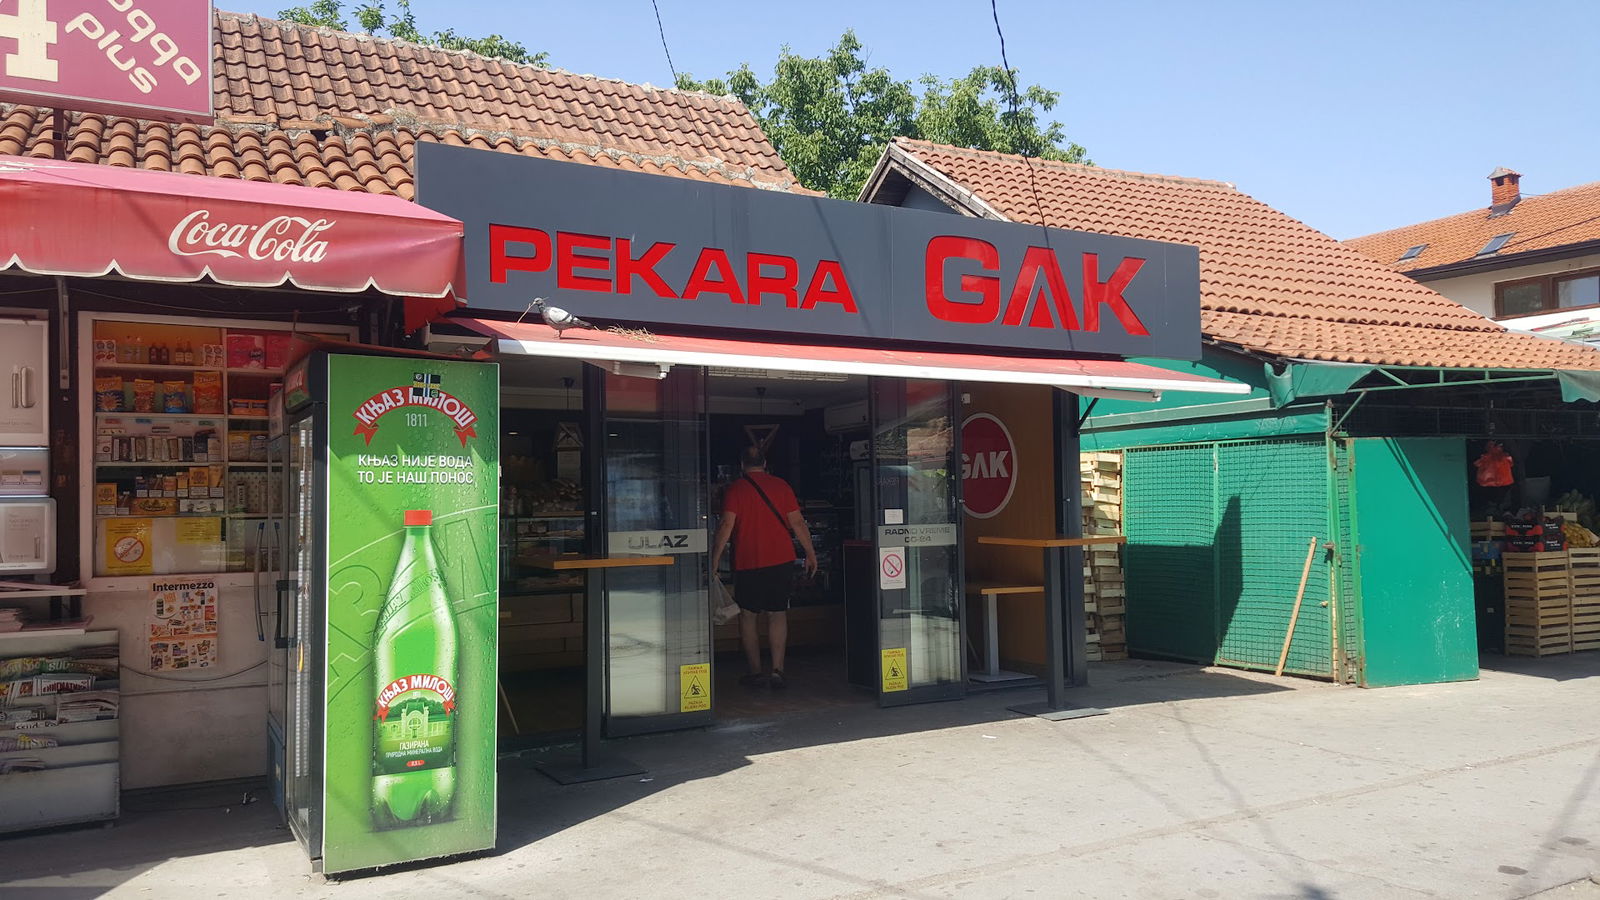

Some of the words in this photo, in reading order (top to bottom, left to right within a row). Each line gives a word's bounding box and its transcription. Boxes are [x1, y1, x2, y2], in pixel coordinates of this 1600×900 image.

[65, 12, 158, 94] plus
[168, 209, 336, 263] Coca-Cola
[489, 223, 858, 313] PEKARA
[925, 235, 1151, 336] GAK
[356, 388, 404, 424] КЊАЗ
[405, 413, 427, 427] 1811
[358, 454, 398, 467] КЊАЗ
[402, 455, 436, 467] НИЈЕ
[440, 455, 473, 469] ВОДА
[358, 471, 375, 483] ТО
[378, 471, 393, 484] ЈЕ
[397, 471, 427, 484] НАШ
[431, 472, 473, 484] ПОНОС
[628, 534, 689, 550] ULAZ
[152, 582, 215, 592] Intermezzo
[378, 678, 408, 708] КЊАЗ
[410, 675, 454, 702] МИЛОШ
